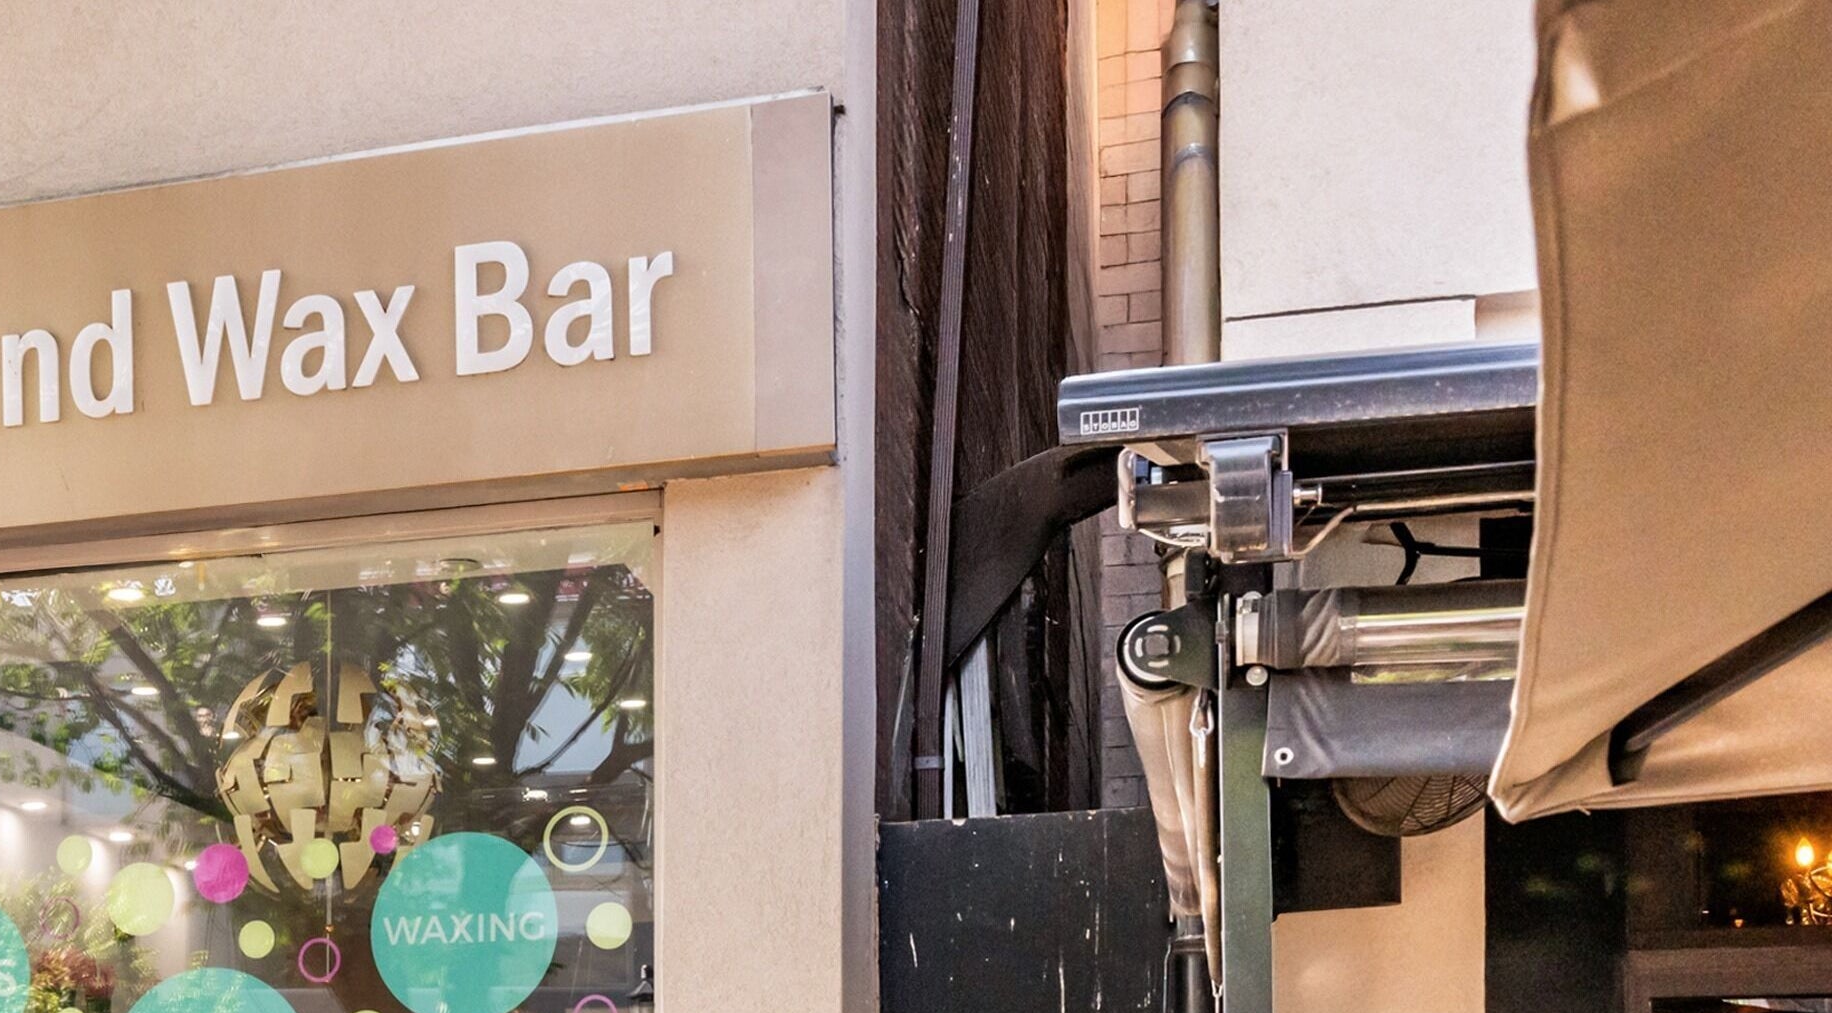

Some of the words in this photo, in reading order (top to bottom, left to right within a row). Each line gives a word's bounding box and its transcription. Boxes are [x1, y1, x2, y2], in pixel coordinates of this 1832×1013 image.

[167, 269, 420, 406] Wax
[453, 240, 673, 377] Bar
[383, 911, 546, 946] WAXING
